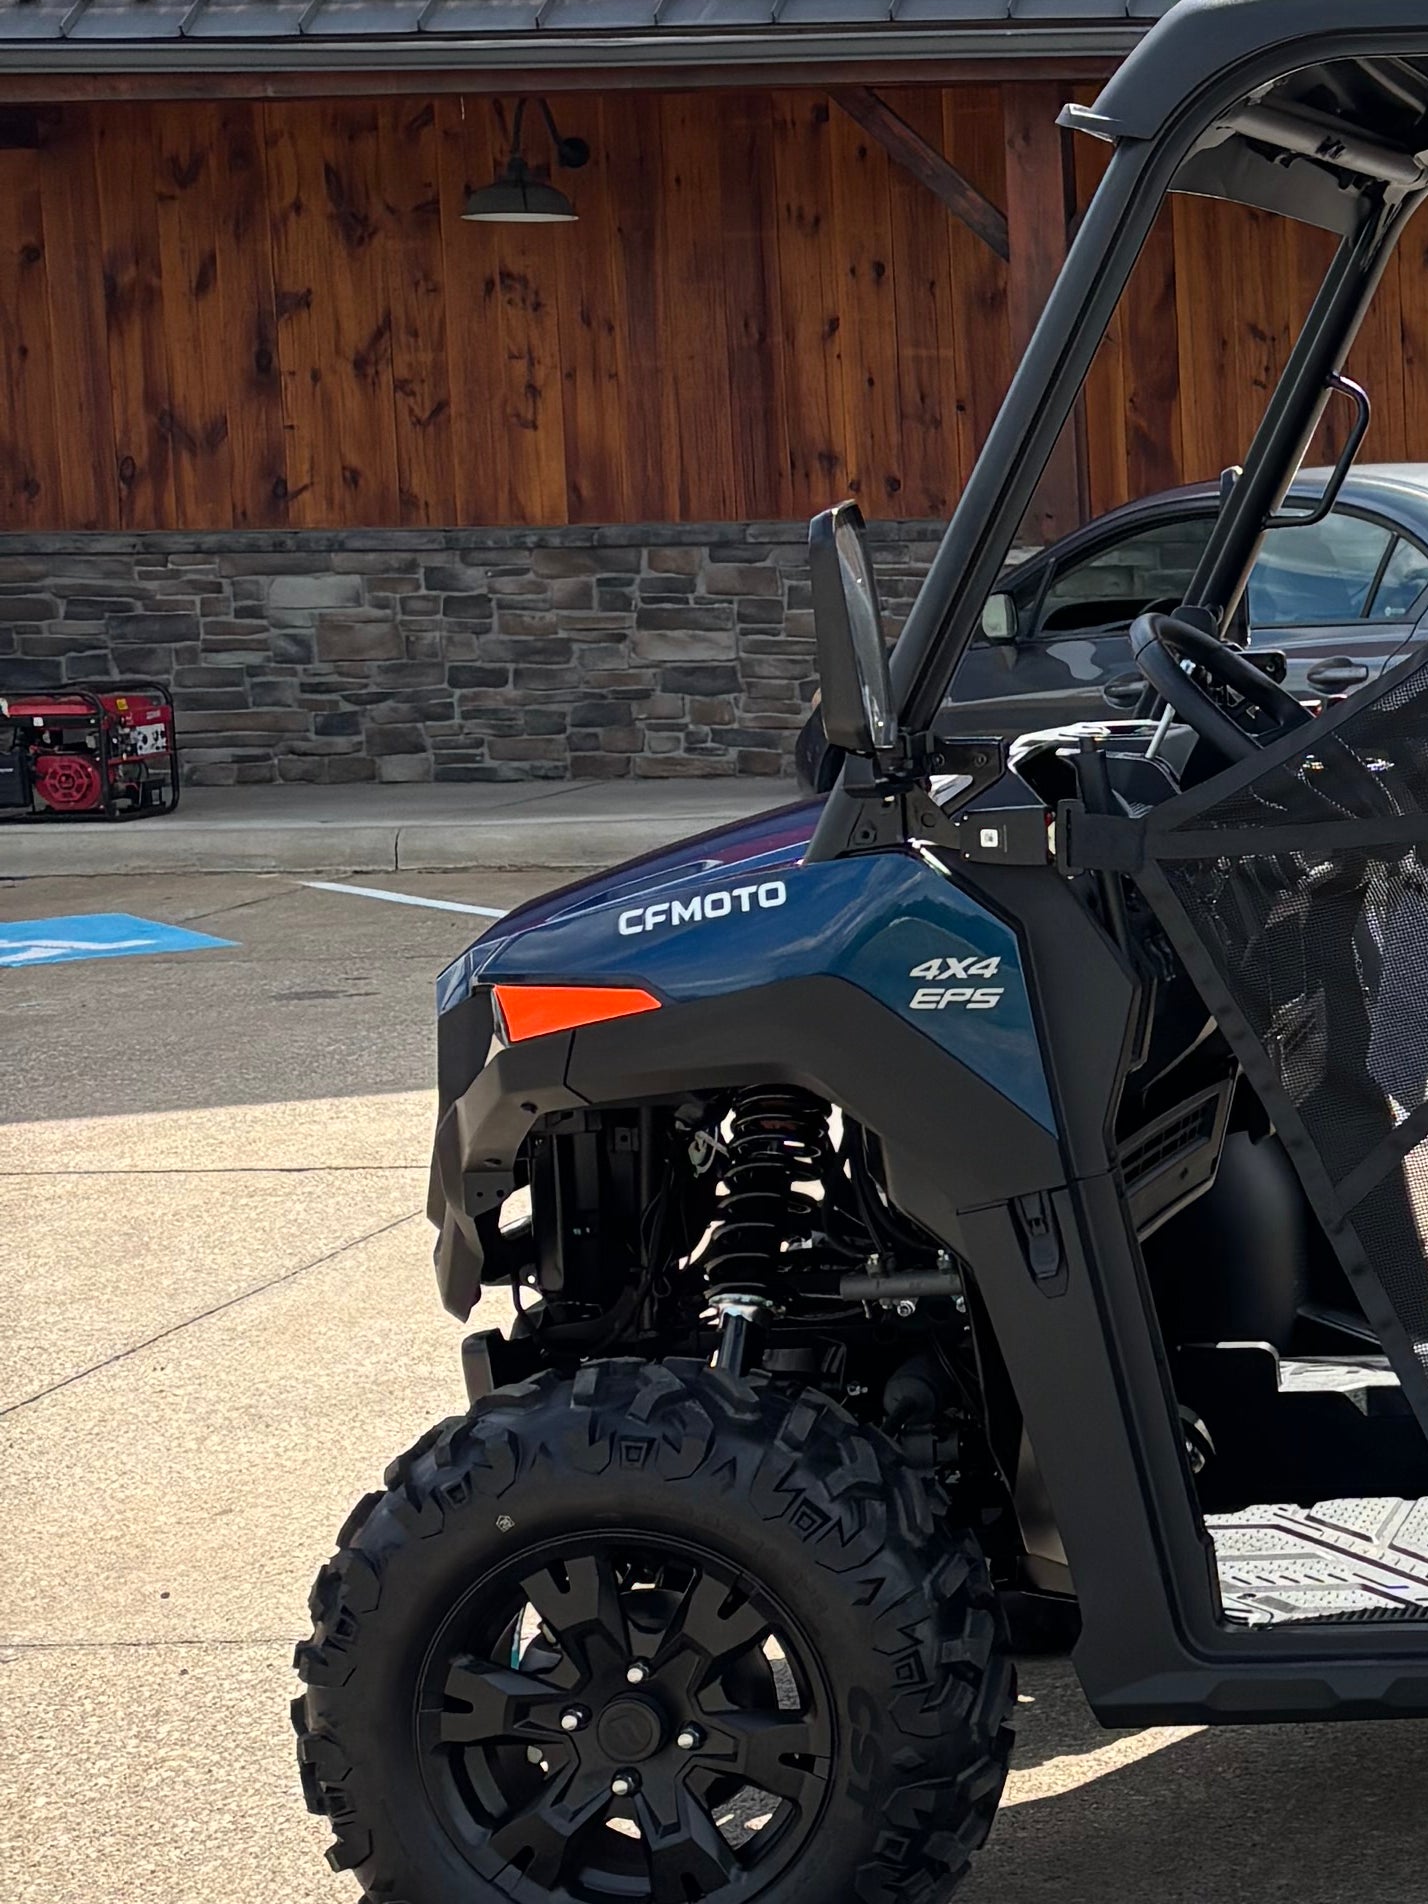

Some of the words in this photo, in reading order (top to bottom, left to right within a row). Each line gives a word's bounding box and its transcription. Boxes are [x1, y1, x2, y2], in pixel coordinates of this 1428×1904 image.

[617, 880, 788, 936] CFMOTO
[909, 956, 1001, 980] 4X4
[909, 987, 1005, 1010] EPS
